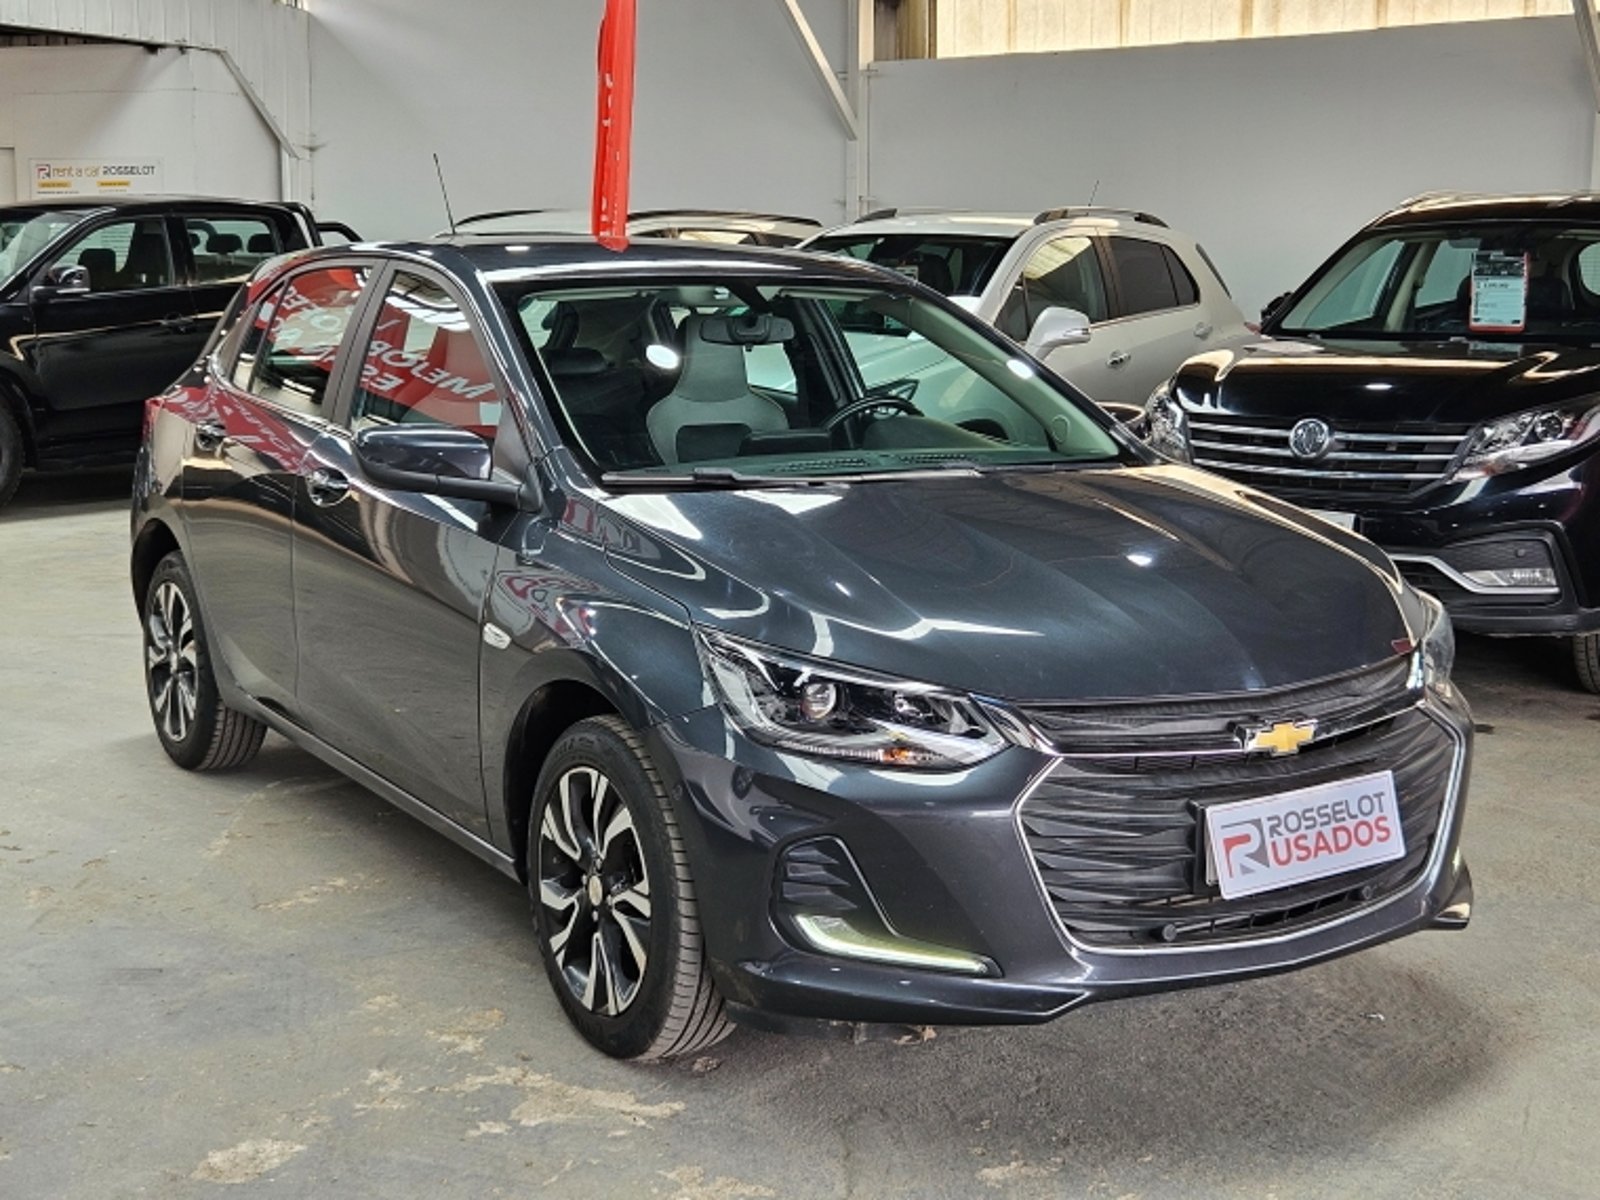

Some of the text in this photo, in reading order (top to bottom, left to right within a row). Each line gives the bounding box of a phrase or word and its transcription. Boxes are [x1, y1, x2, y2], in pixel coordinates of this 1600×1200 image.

[52, 166, 74, 177] rent
[75, 168, 82, 177] a
[84, 167, 100, 177] car
[102, 166, 155, 175] ROSSELOT
[1267, 792, 1385, 838] ROSSELOT
[1271, 816, 1391, 866] USADOS
